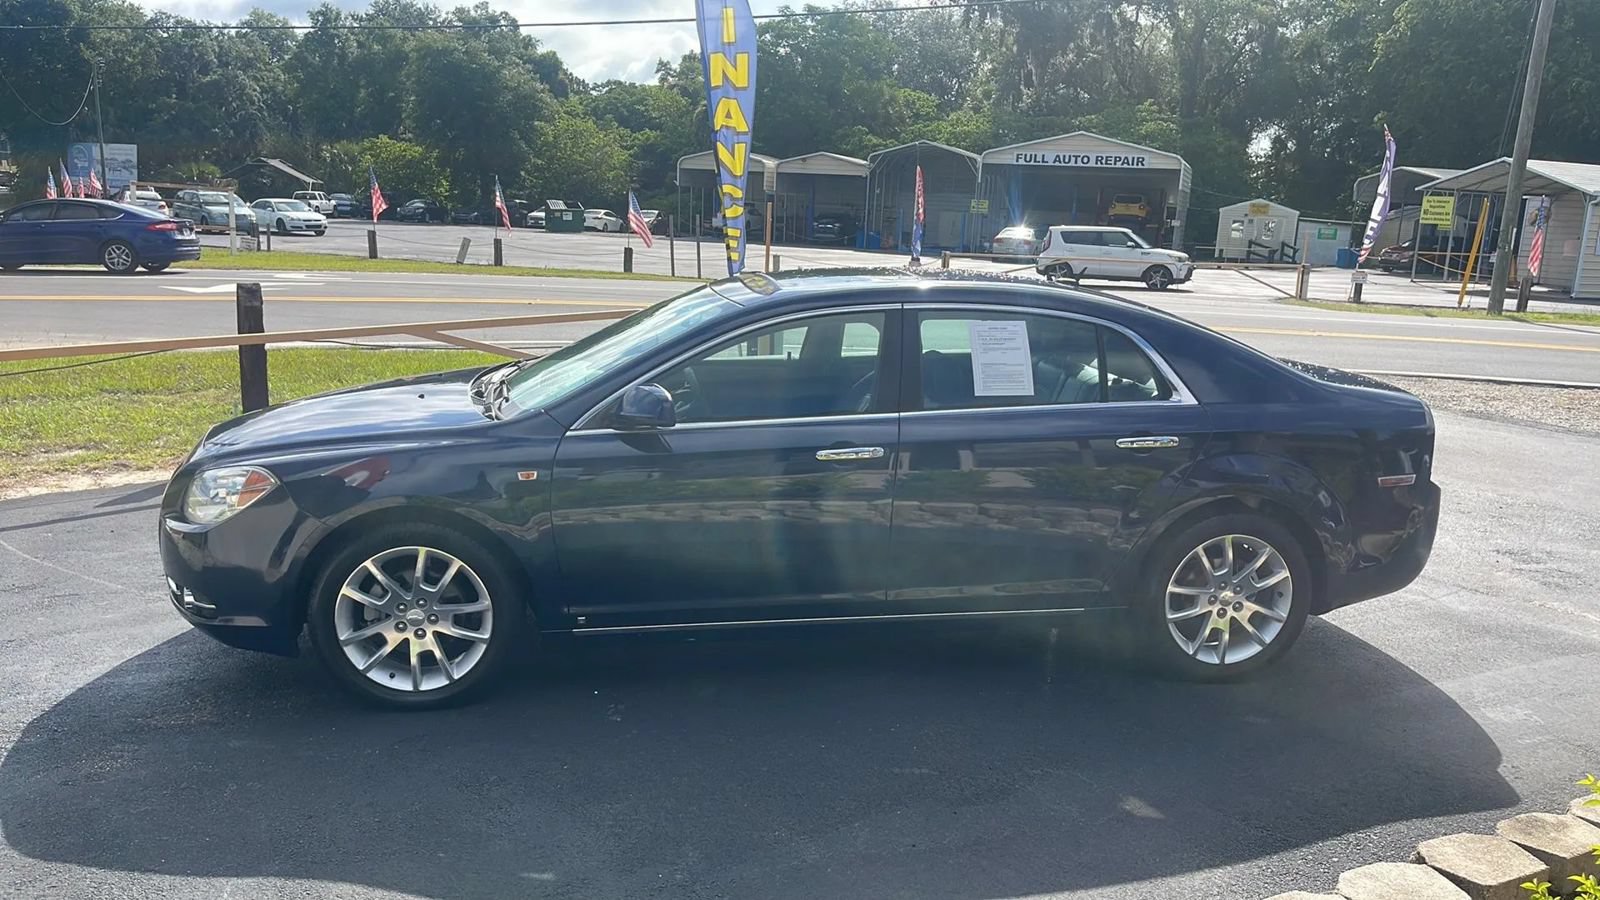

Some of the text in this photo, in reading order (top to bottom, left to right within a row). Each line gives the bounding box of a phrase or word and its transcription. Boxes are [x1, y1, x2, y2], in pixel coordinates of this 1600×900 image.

[1015, 153, 1145, 167] FULL AUTO REPAIR
